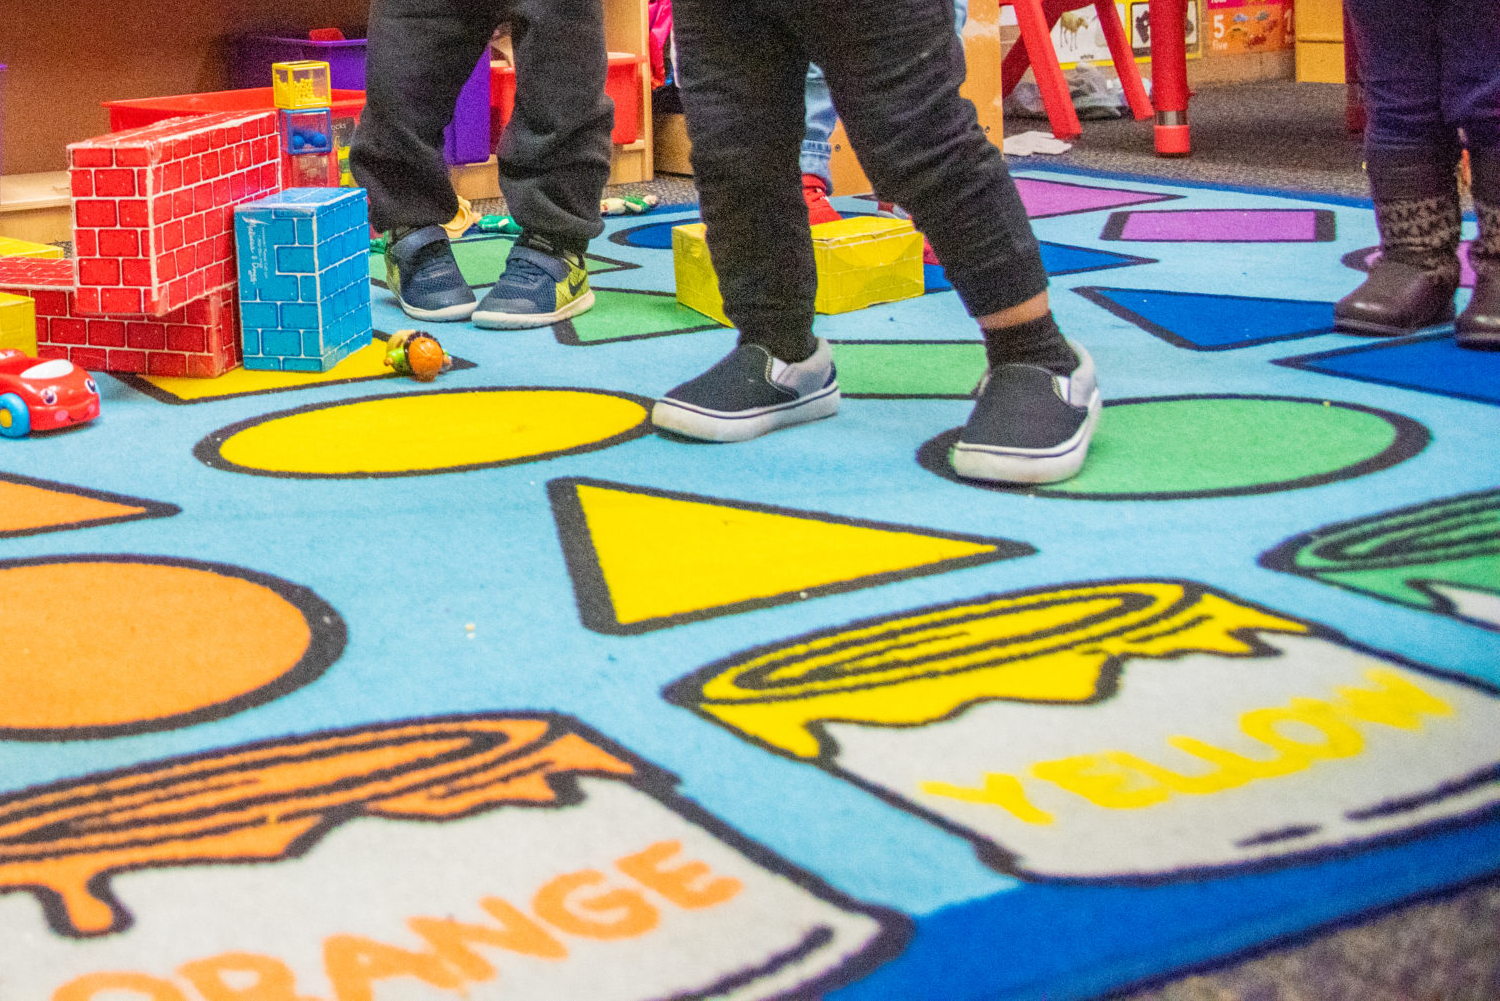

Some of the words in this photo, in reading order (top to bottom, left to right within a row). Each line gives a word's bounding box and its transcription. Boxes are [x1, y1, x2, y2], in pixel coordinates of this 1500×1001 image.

[1213, 14, 1225, 39] 5
[1212, 41, 1228, 51] five
[919, 667, 1454, 827] YELLOW
